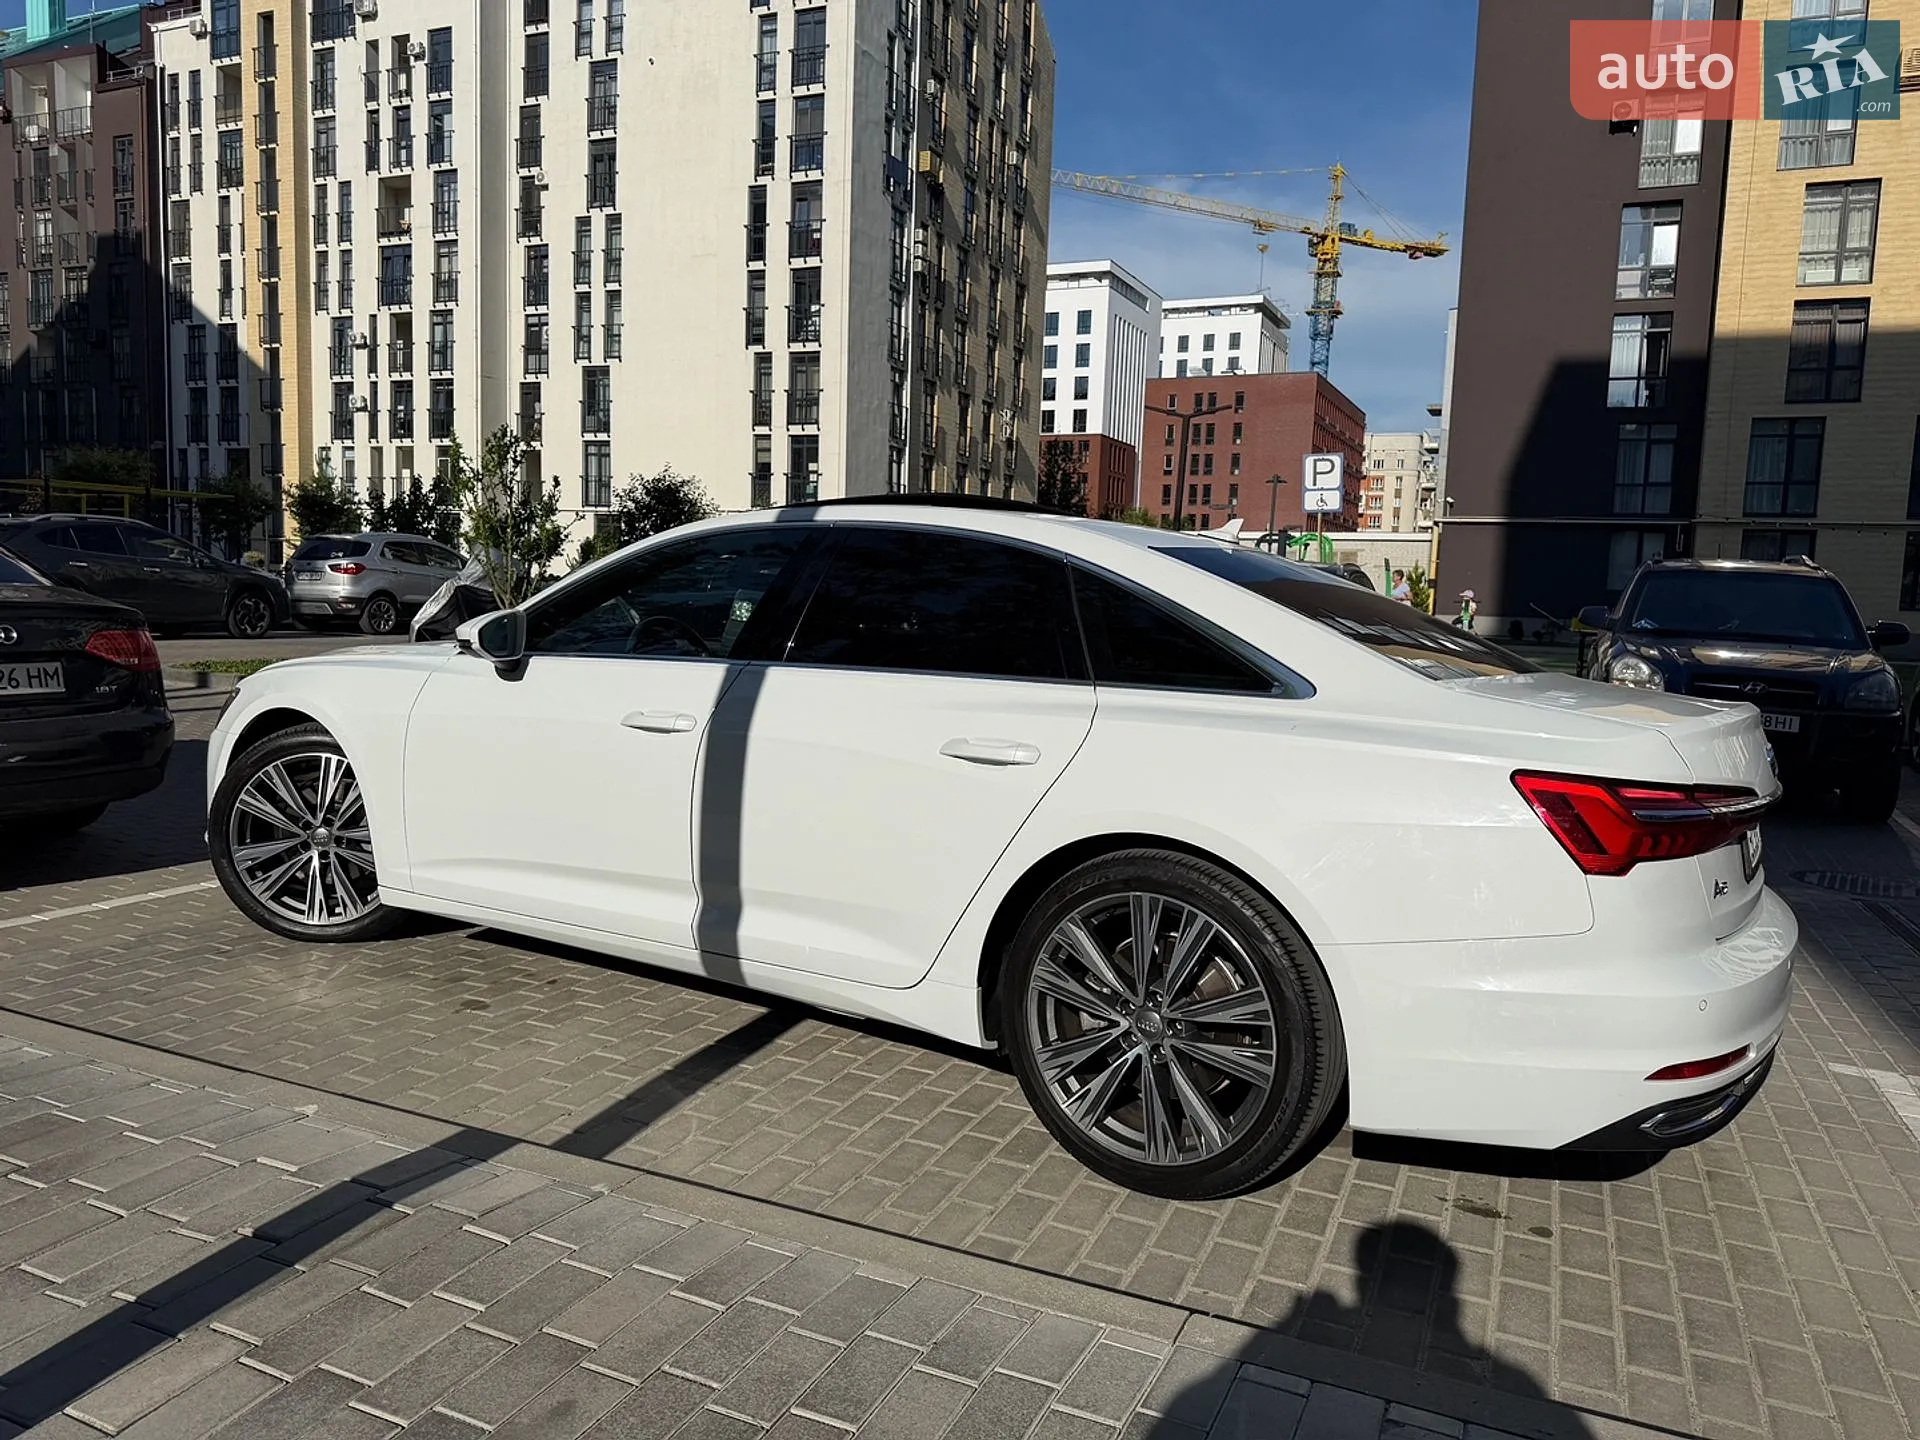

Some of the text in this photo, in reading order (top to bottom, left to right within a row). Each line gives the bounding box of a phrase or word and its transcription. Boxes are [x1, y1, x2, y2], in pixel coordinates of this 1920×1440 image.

[1312, 457, 1336, 487] P
[26, 666, 61, 689] HM
[1774, 716, 1793, 730] HI
